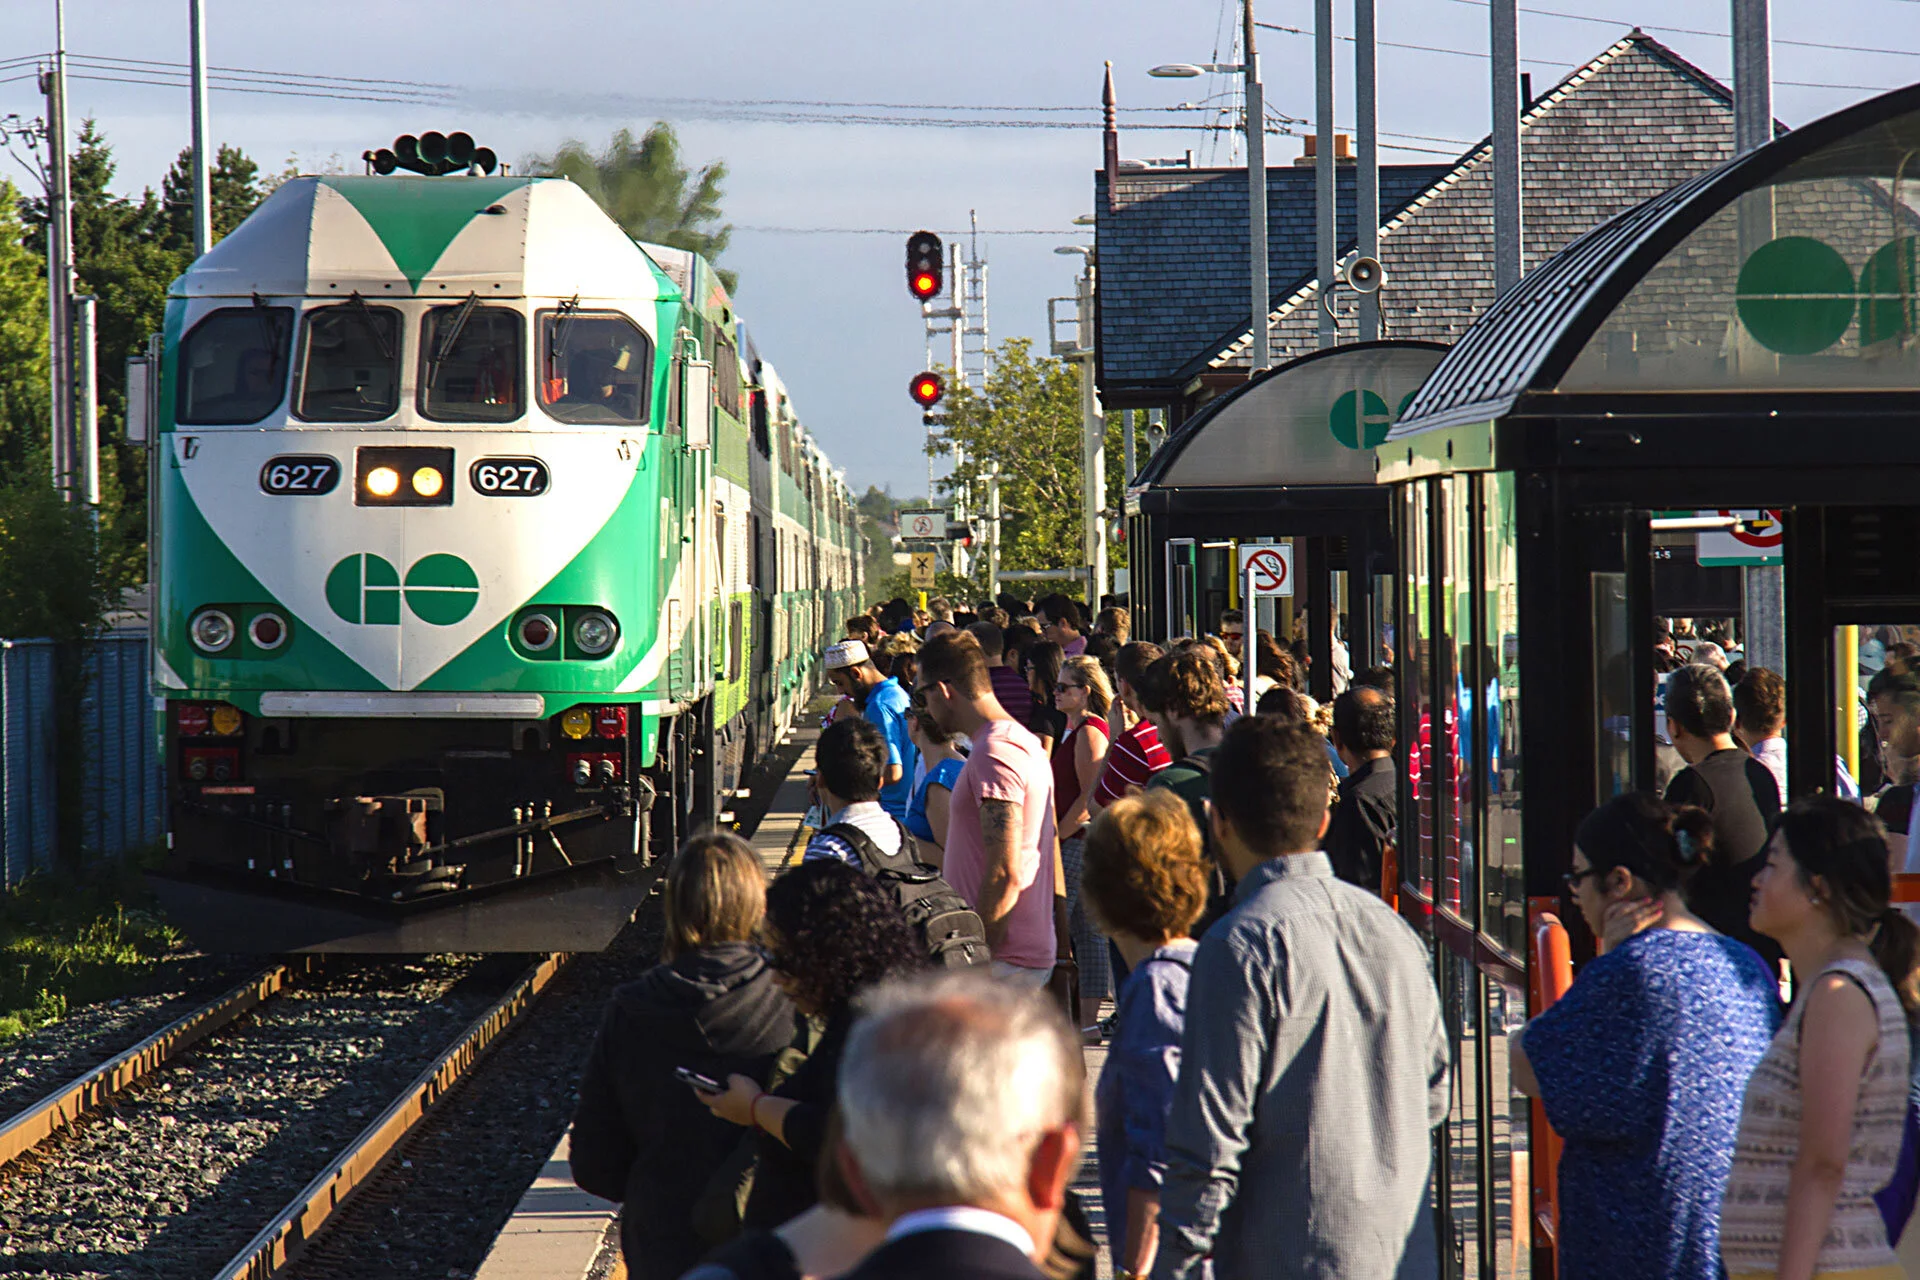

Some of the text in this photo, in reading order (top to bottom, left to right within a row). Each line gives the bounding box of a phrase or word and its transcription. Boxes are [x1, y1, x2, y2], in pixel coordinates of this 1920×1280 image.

[1328, 389, 1419, 450] G
[270, 464, 331, 489] 627
[479, 465, 539, 490] 627
[325, 552, 479, 626] GO
